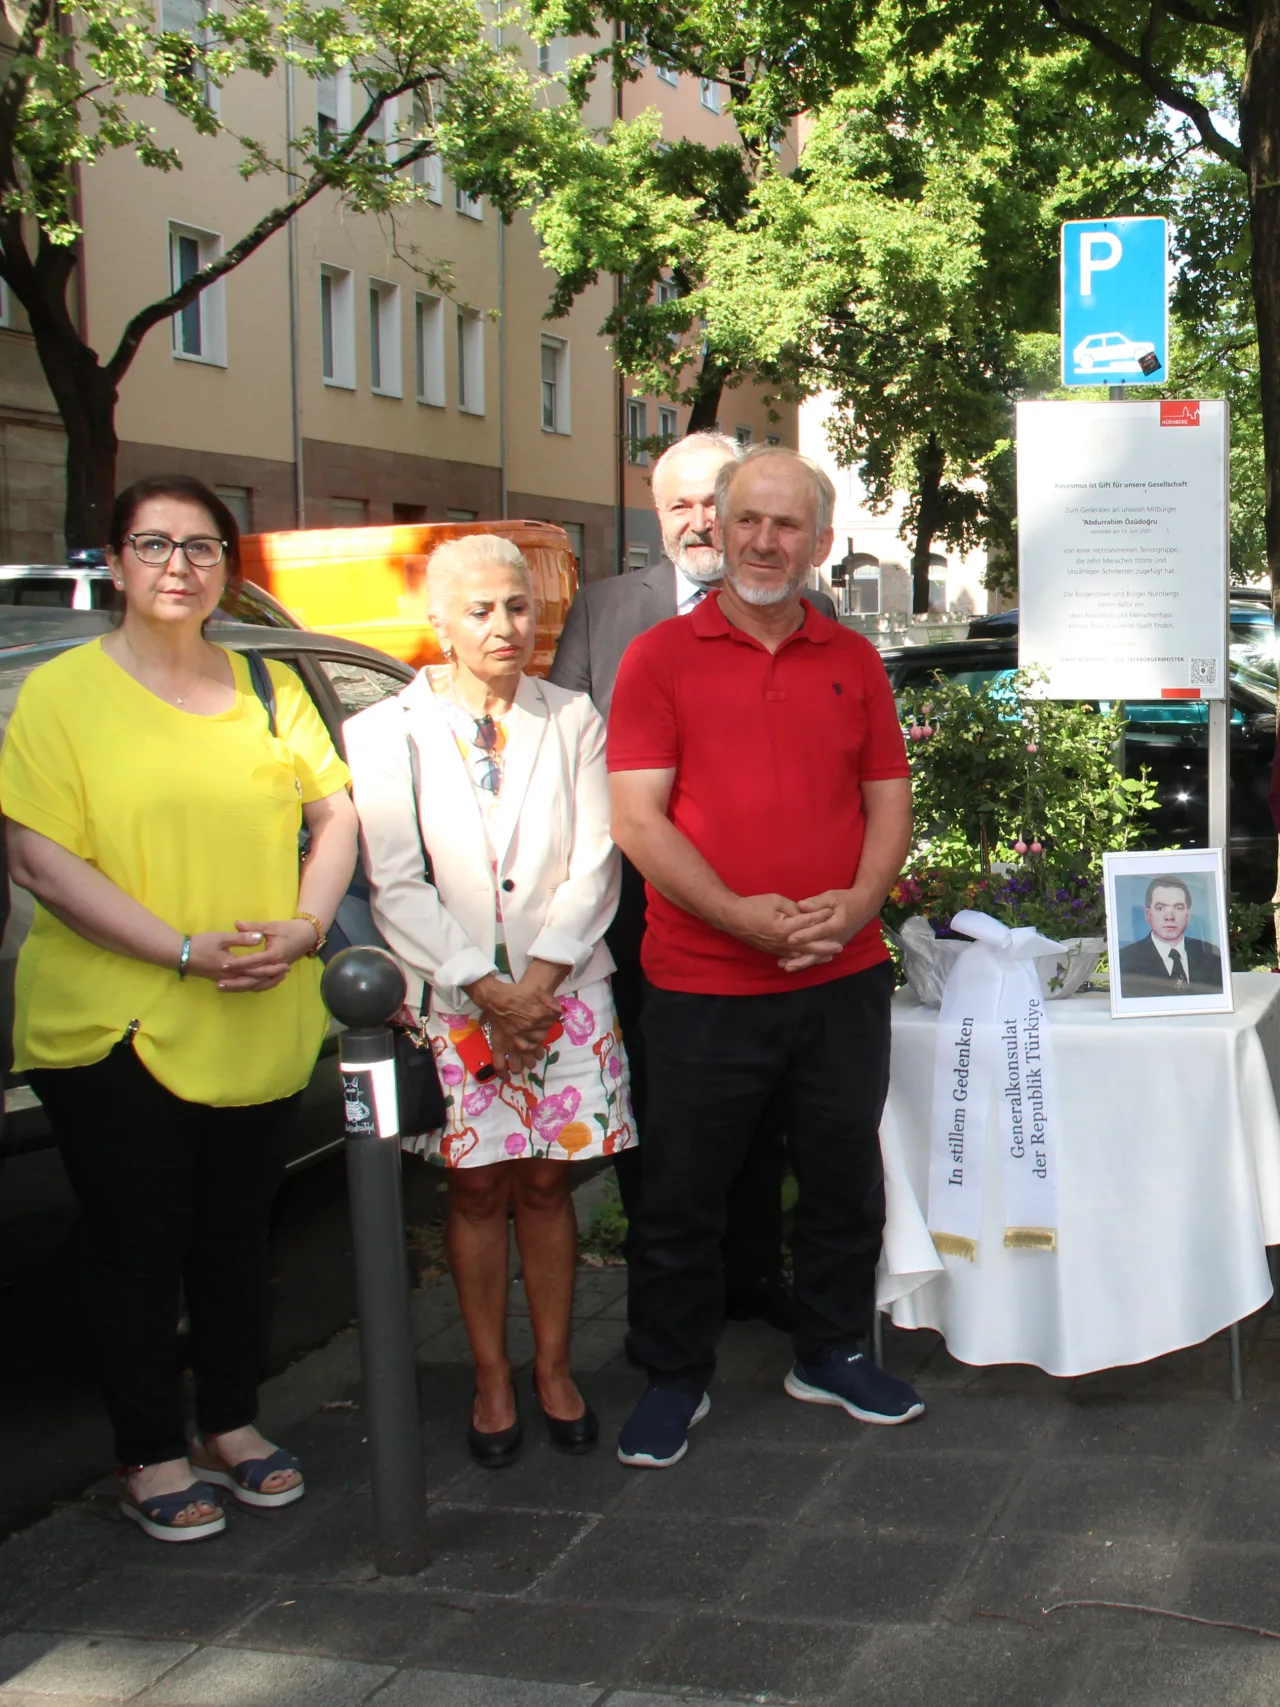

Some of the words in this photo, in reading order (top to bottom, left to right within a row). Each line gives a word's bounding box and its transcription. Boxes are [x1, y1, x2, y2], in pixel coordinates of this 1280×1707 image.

[1080, 231, 1123, 296] P
[1098, 481, 1111, 489] Gift
[1125, 518, 1158, 526] Özüdoğru
[1146, 506, 1177, 514] Mitbürger
[1101, 567, 1135, 575] Schmerzen
[1135, 567, 1163, 575] zugefügt
[1113, 590, 1125, 598] und
[1128, 611, 1173, 619] Menschenhass
[1023, 998, 1044, 1064] Türkiye
[952, 1016, 975, 1102] Gedenken
[1001, 1018, 1025, 1159] Generalkonsulat
[1026, 1067, 1048, 1146] Republik
[948, 1108, 966, 1164] stillem
[1032, 1150, 1047, 1179] der
[948, 1168, 963, 1187] In
